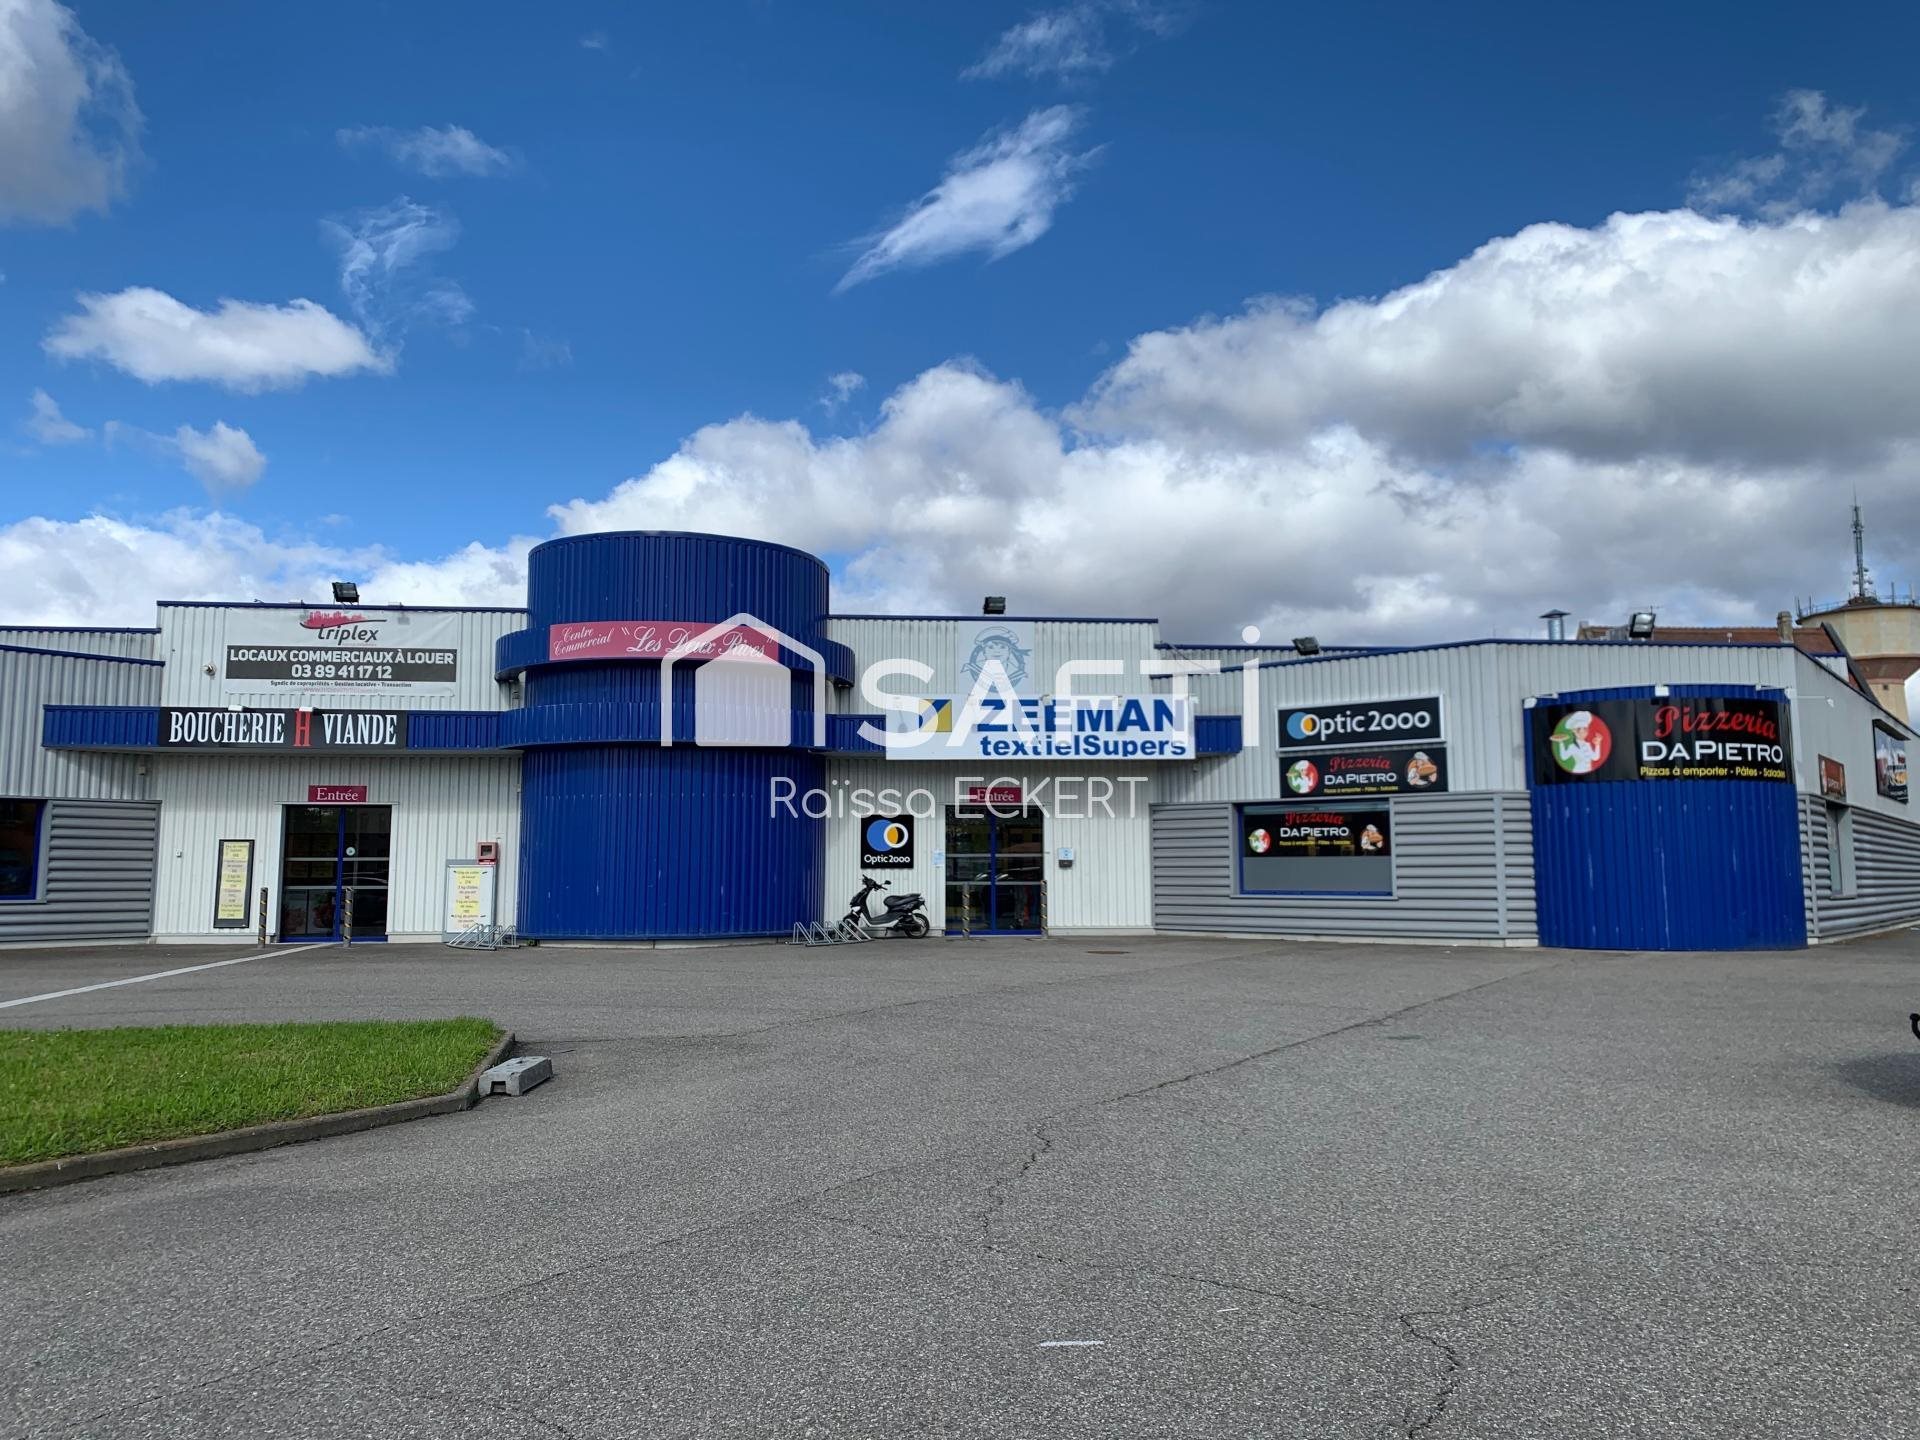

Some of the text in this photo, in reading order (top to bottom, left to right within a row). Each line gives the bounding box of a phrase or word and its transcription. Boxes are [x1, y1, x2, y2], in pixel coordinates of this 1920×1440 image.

[318, 624, 379, 646] triplex
[553, 628, 614, 656] Commercial
[562, 626, 594, 642] Centre
[230, 649, 454, 664] LOCAUX COMMERCIAUX À LOUER
[291, 664, 392, 679] 03 89 41 17 12
[974, 698, 1186, 732] ZEEMAN
[1654, 705, 1777, 739] Pizzeria
[169, 709, 398, 747] BOUCHERIE H VIANDE
[1300, 711, 1365, 741] Optic
[980, 734, 1187, 757] textielSupers
[1642, 740, 1784, 763] DA PIETRO
[1329, 755, 1392, 773] Pizzeria
[1640, 766, 1670, 776] Pizzas
[1683, 766, 1728, 777] emporter
[1735, 766, 1758, 777] Pâtes
[317, 788, 358, 801] Entrée
[976, 788, 1015, 802] Entrée
[1284, 811, 1345, 826] Pizzeria
